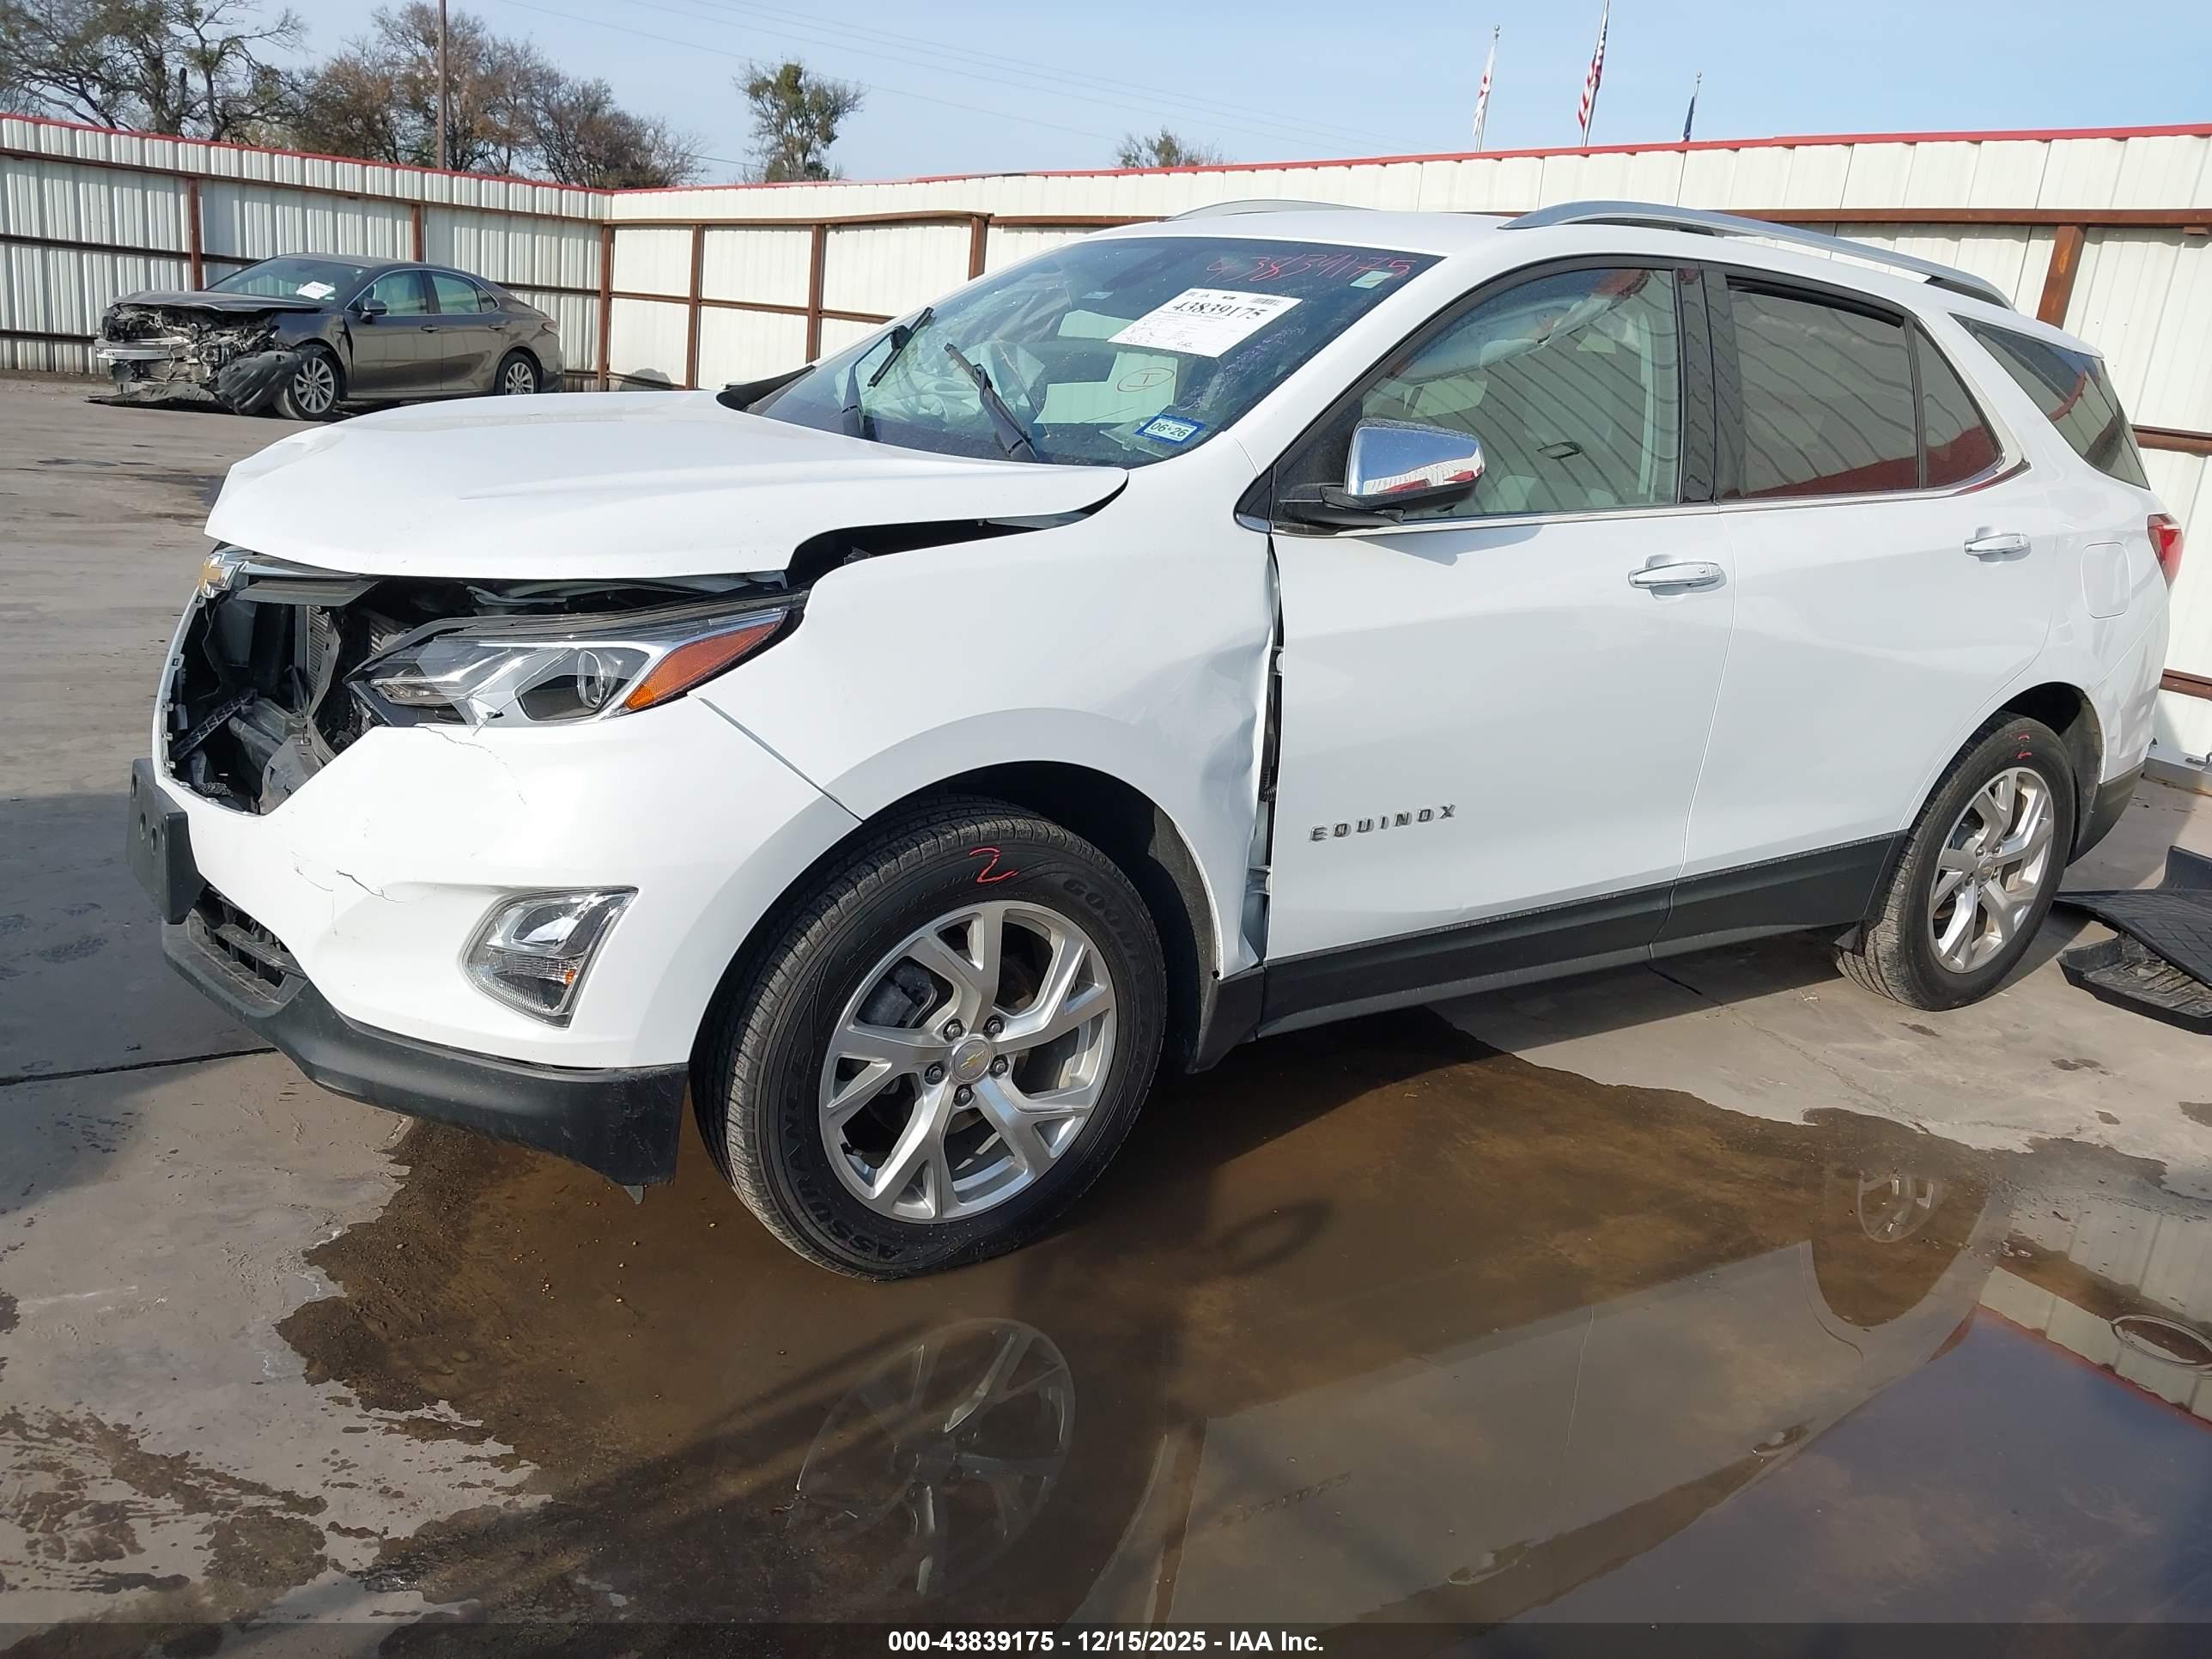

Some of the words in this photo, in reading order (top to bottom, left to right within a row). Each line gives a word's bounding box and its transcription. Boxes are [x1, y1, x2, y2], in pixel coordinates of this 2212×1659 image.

[1172, 301, 1267, 319] 43839175
[1309, 804, 1456, 842] EQUINOX
[969, 846, 1018, 884] 2
